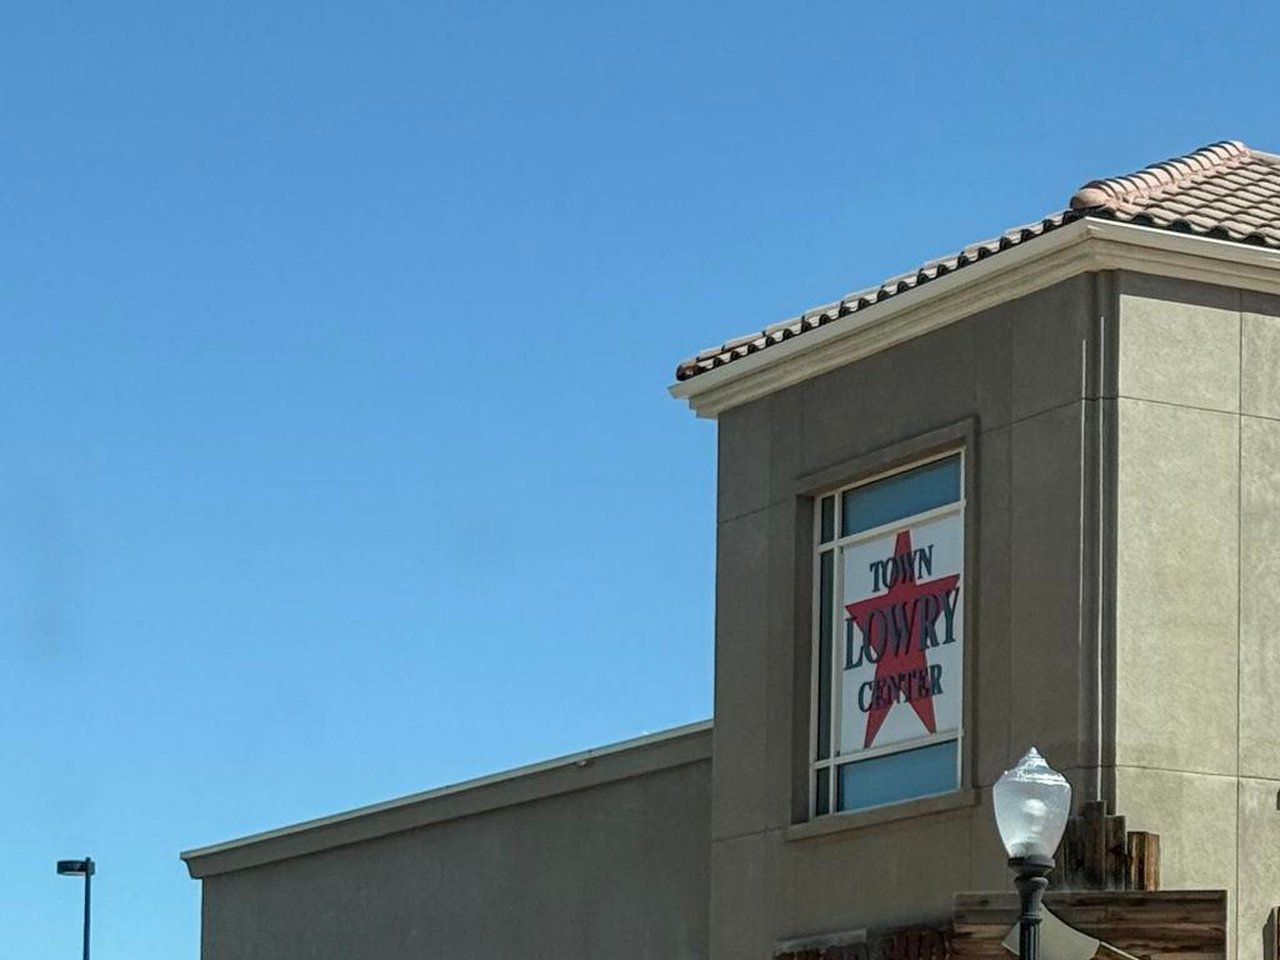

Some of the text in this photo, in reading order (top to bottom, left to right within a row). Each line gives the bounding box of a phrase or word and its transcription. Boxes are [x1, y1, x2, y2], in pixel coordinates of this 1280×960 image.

[870, 545, 934, 593] TOWN
[844, 587, 960, 671] LOWRY
[858, 664, 944, 713] CENTER
